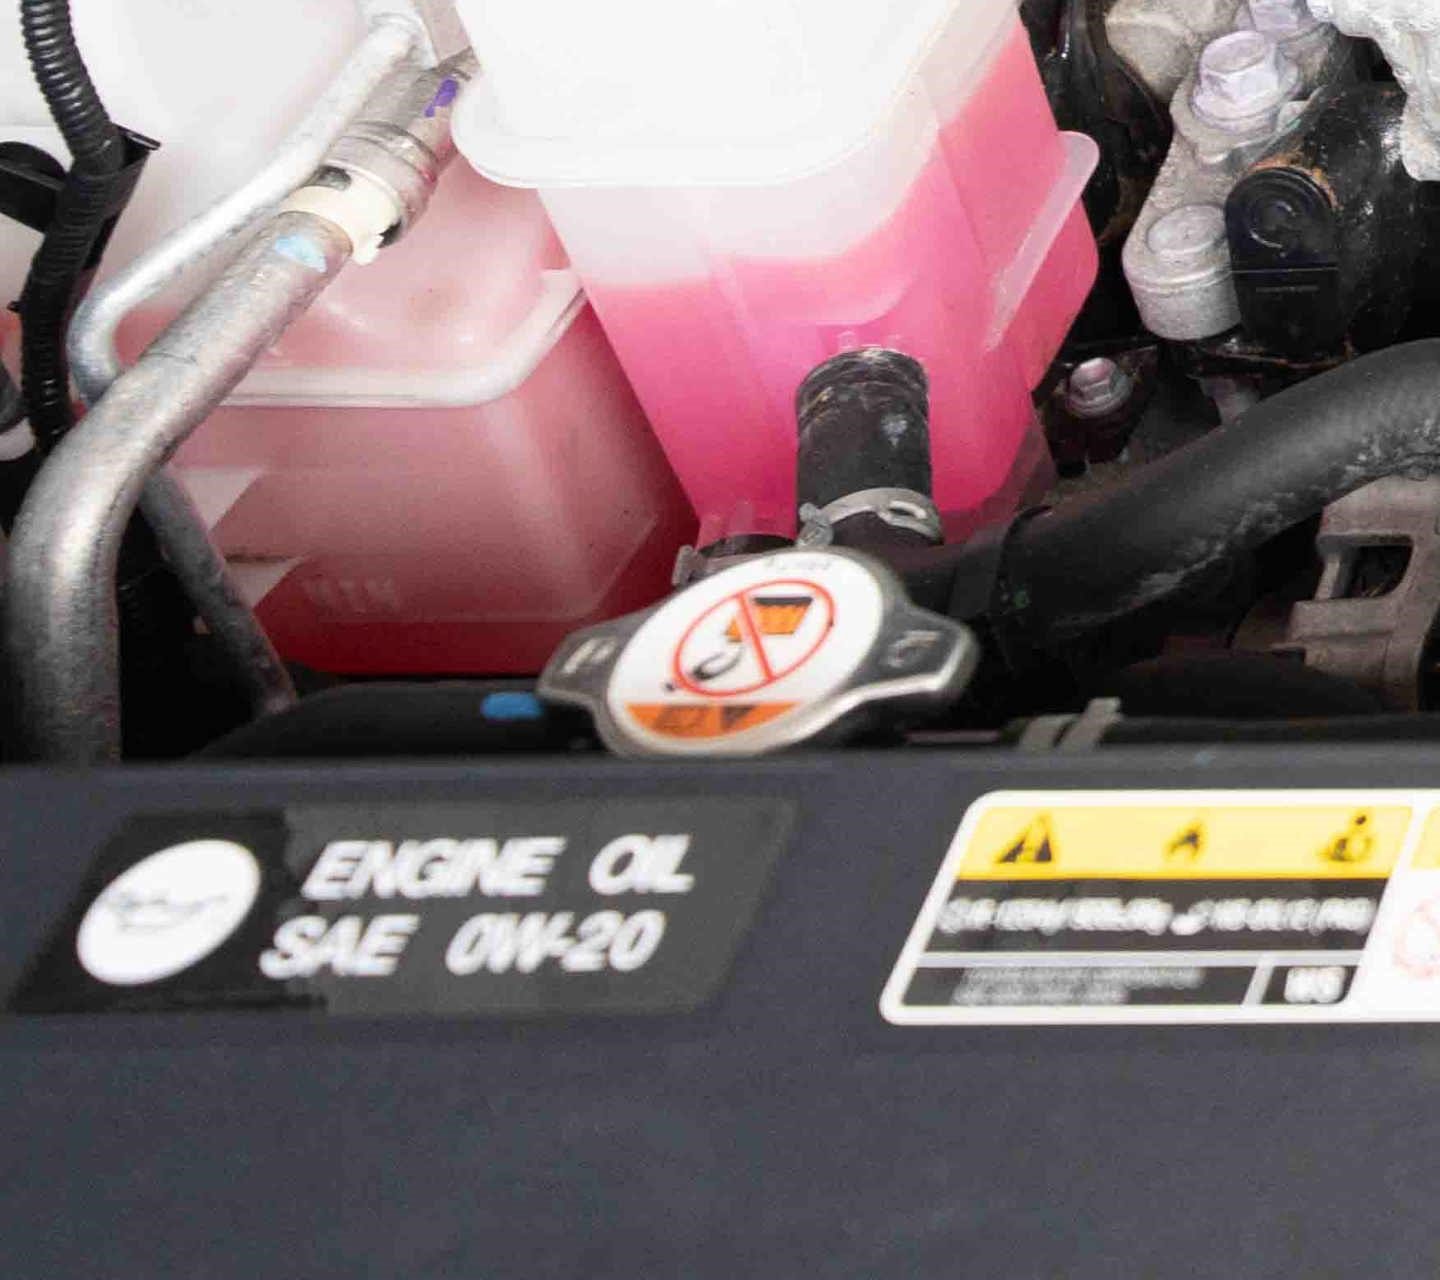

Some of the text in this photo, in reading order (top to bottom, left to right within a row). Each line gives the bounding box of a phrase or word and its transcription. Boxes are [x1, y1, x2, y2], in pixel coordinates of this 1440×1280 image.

[301, 832, 695, 900] ENGINE OIL
[259, 913, 419, 979] SAE
